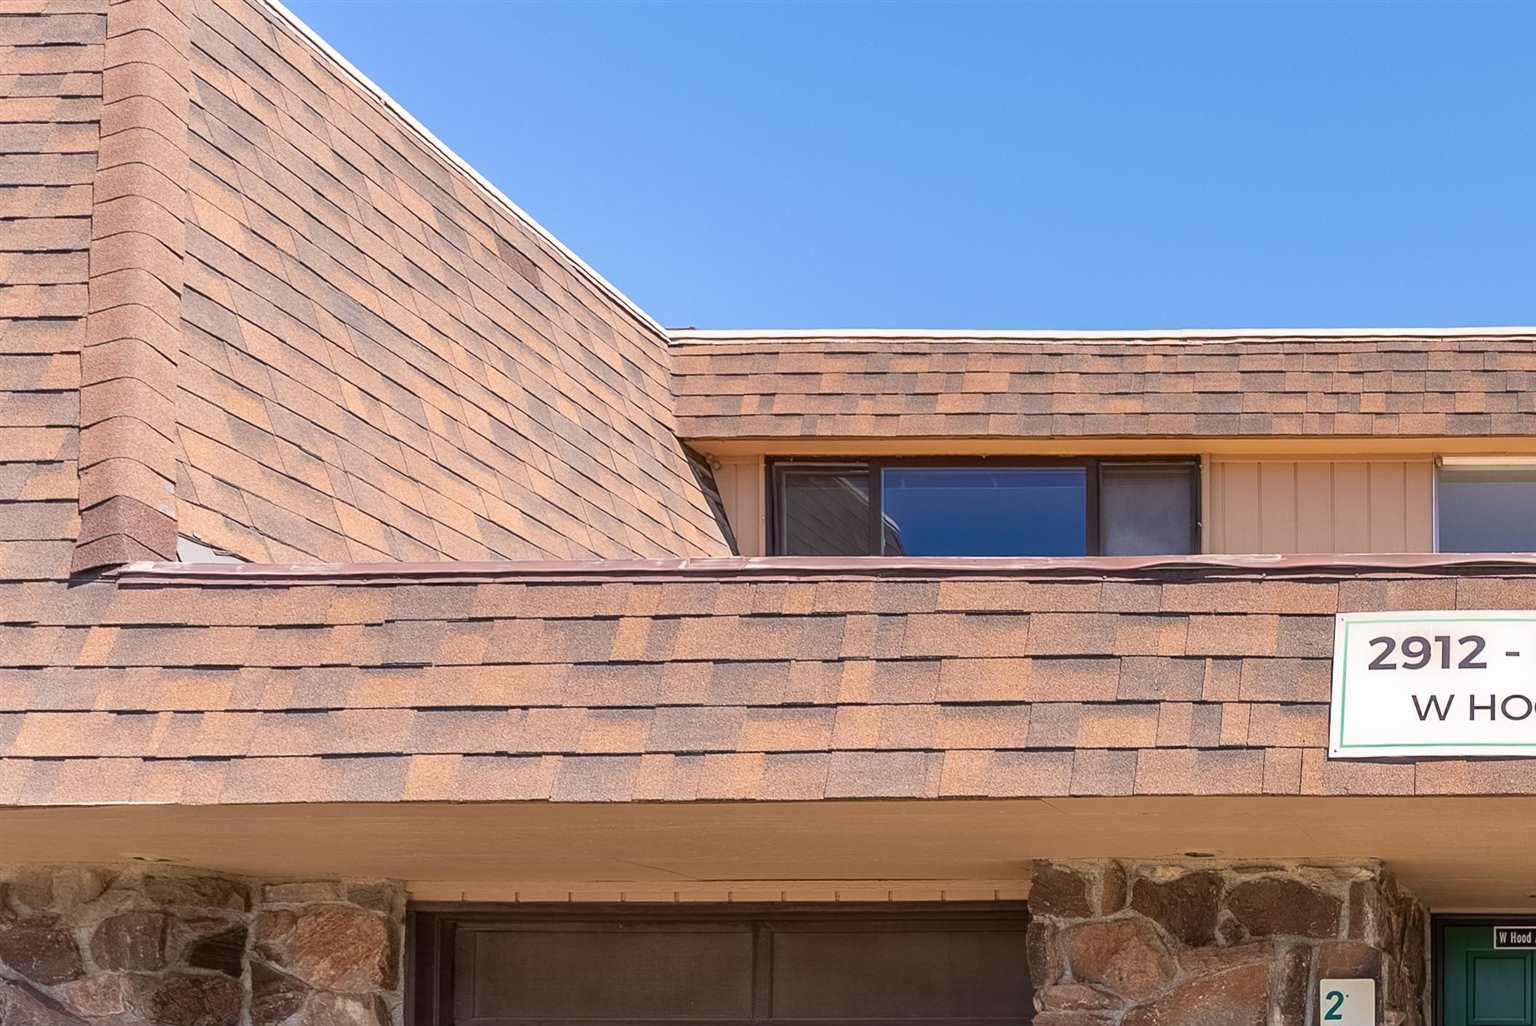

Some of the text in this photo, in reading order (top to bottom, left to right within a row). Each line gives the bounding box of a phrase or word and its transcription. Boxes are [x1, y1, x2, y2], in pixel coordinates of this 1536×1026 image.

[1368, 634, 1488, 671] 2912
[1411, 694, 1455, 721] W
[1499, 932, 1506, 943] W
[1510, 932, 1531, 944] Hood
